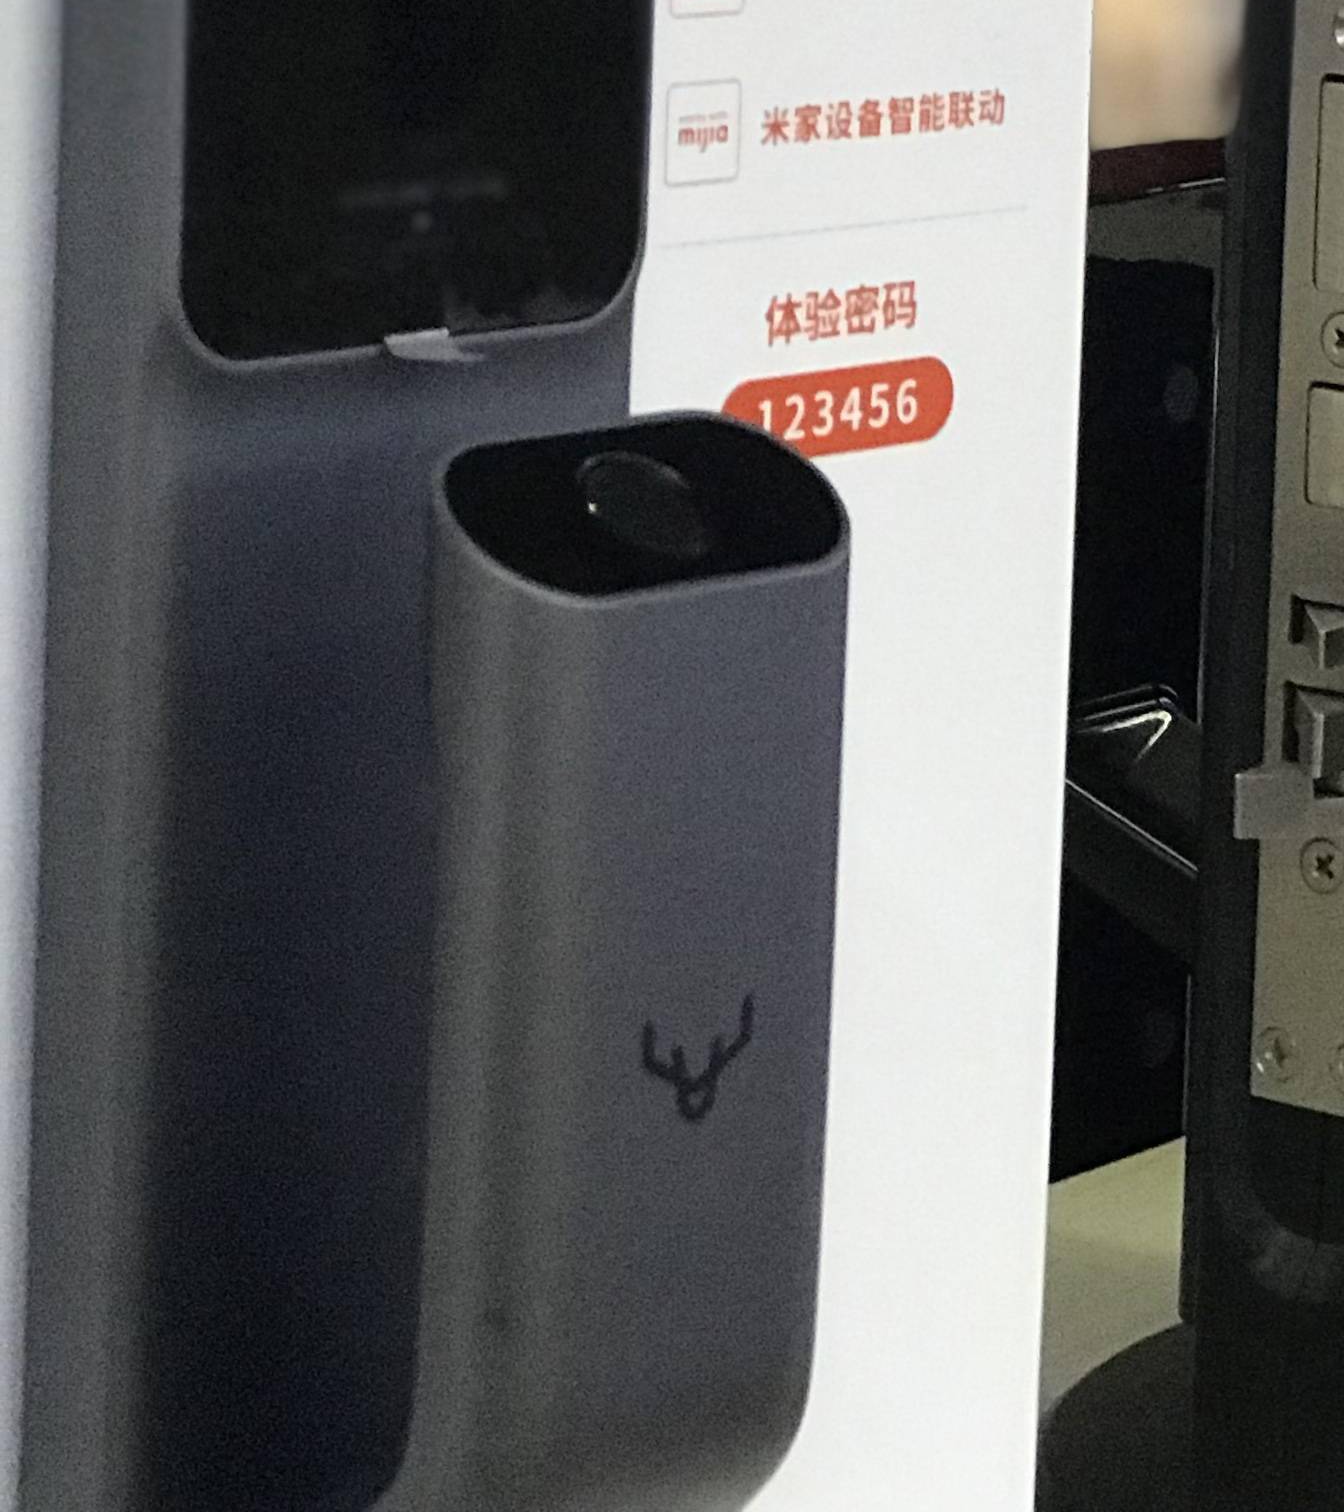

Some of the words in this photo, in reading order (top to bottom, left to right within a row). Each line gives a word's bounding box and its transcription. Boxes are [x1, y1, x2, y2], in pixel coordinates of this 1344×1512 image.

[761, 88, 1006, 145] 米家设备智能联动
[765, 280, 917, 347] 体验密码
[759, 378, 918, 440] 123456
